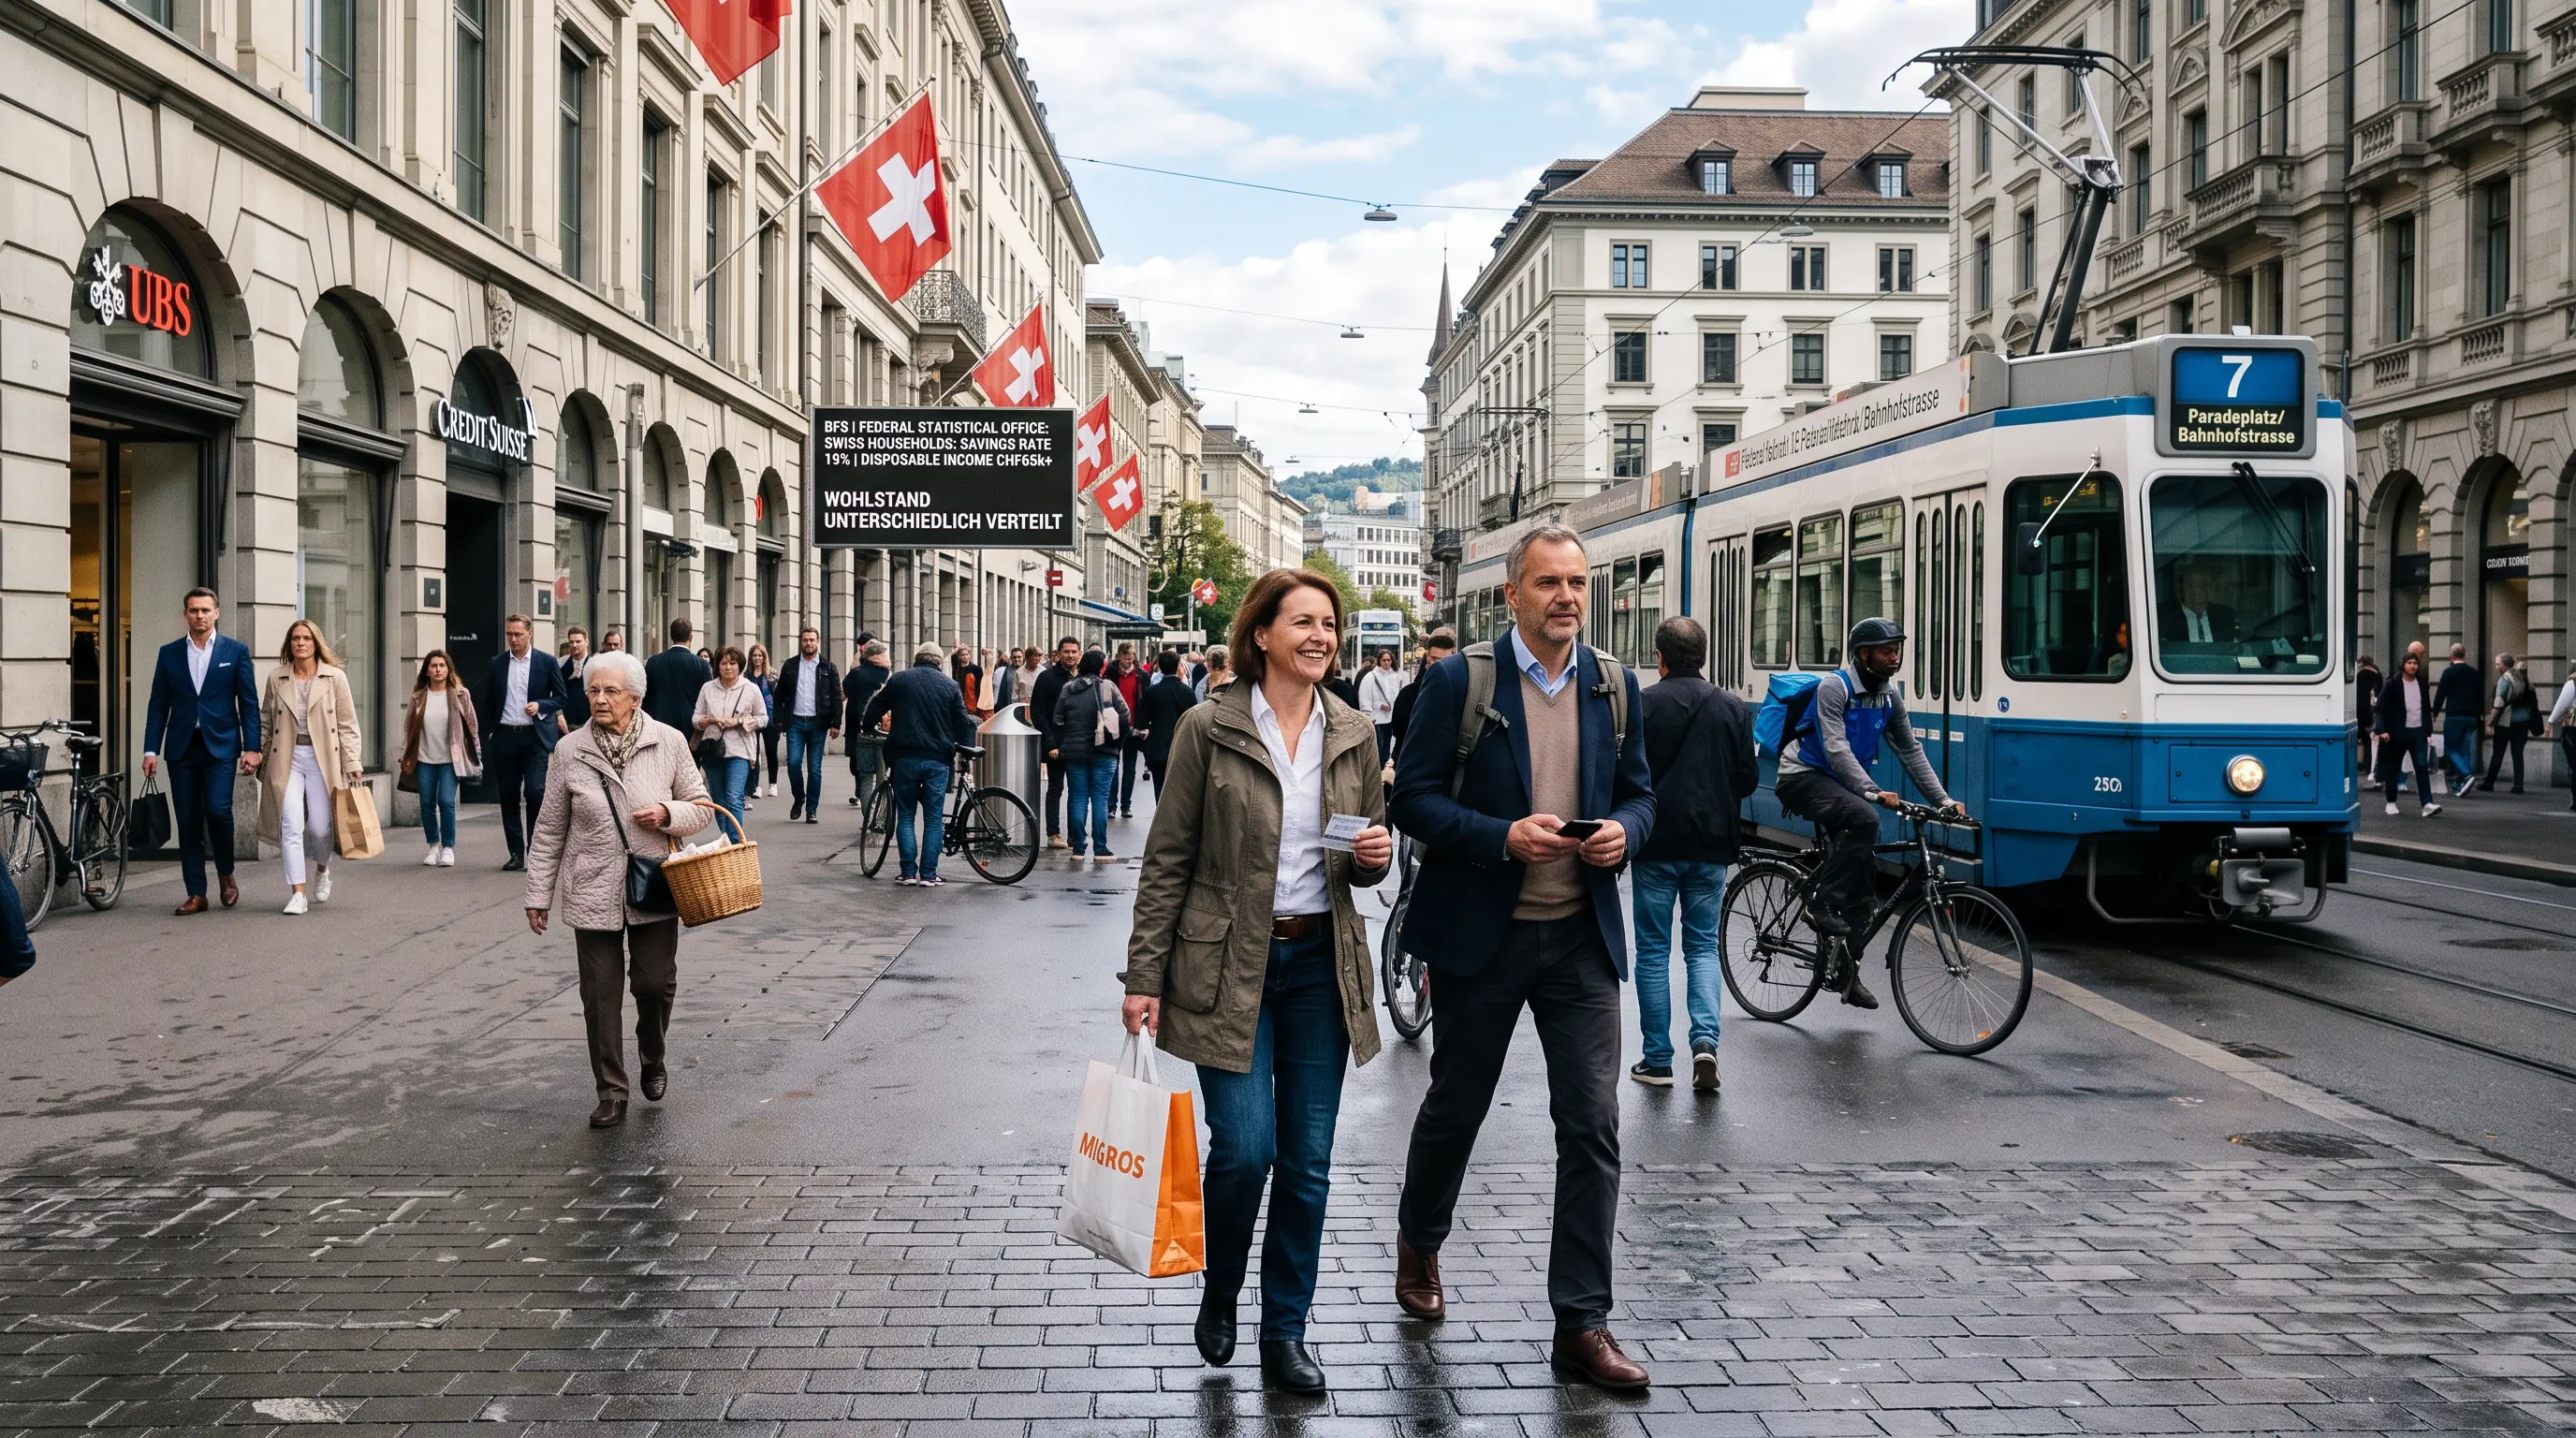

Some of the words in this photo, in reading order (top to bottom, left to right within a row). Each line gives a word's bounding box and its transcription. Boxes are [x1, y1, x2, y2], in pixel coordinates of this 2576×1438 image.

[128, 264, 191, 336] UBS
[2221, 355, 2253, 398] 7
[2188, 408, 2286, 427] Paradeplatz/
[437, 397, 488, 448] CREDIT
[489, 415, 528, 462] SUISSE
[824, 420, 849, 433] BFS
[858, 420, 915, 433] FEDERAL
[917, 420, 999, 434] STATISTICAL
[1001, 421, 1049, 434] OFFICE:
[2178, 427, 2295, 443] Bahnhofstrasse
[824, 436, 865, 449] SWISS
[868, 437, 957, 450] HOUSEHOLDS:
[959, 437, 1017, 451] SAVINGS
[1018, 438, 1052, 451] RATE
[825, 452, 851, 465] 19%
[860, 452, 941, 466] DISPOSABLE
[944, 453, 994, 466] INCOME
[996, 453, 1053, 466] CHF65k+
[824, 491, 931, 508] WOHLSTAND
[824, 512, 981, 529] UNTERSCHIEDLICH
[986, 513, 1063, 530] VERTEILT
[1078, 1132, 1145, 1179] MIGROS
